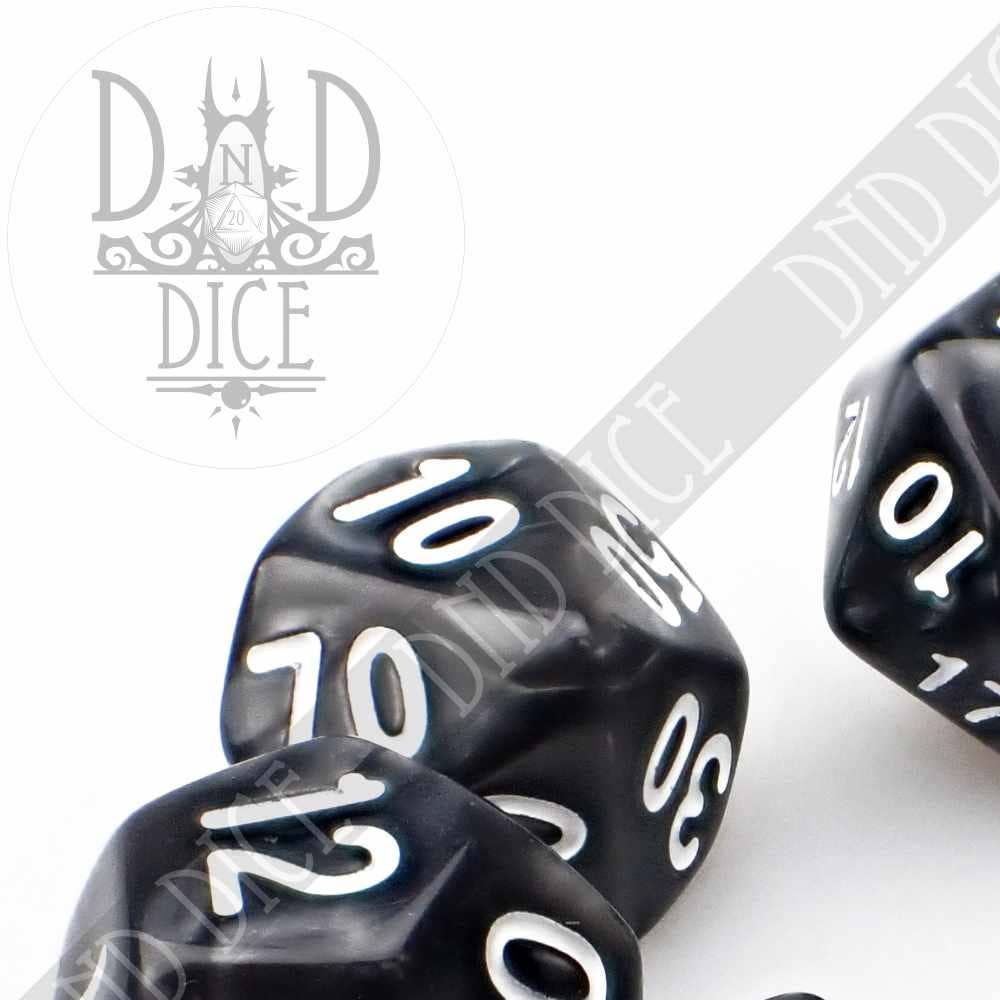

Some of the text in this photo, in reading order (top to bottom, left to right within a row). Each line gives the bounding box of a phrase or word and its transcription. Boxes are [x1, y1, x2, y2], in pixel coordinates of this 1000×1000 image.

[332, 458, 521, 566] 10
[879, 462, 984, 598] 10
[246, 626, 428, 759] 70
[201, 771, 400, 916] 12
[643, 693, 733, 871] 30
